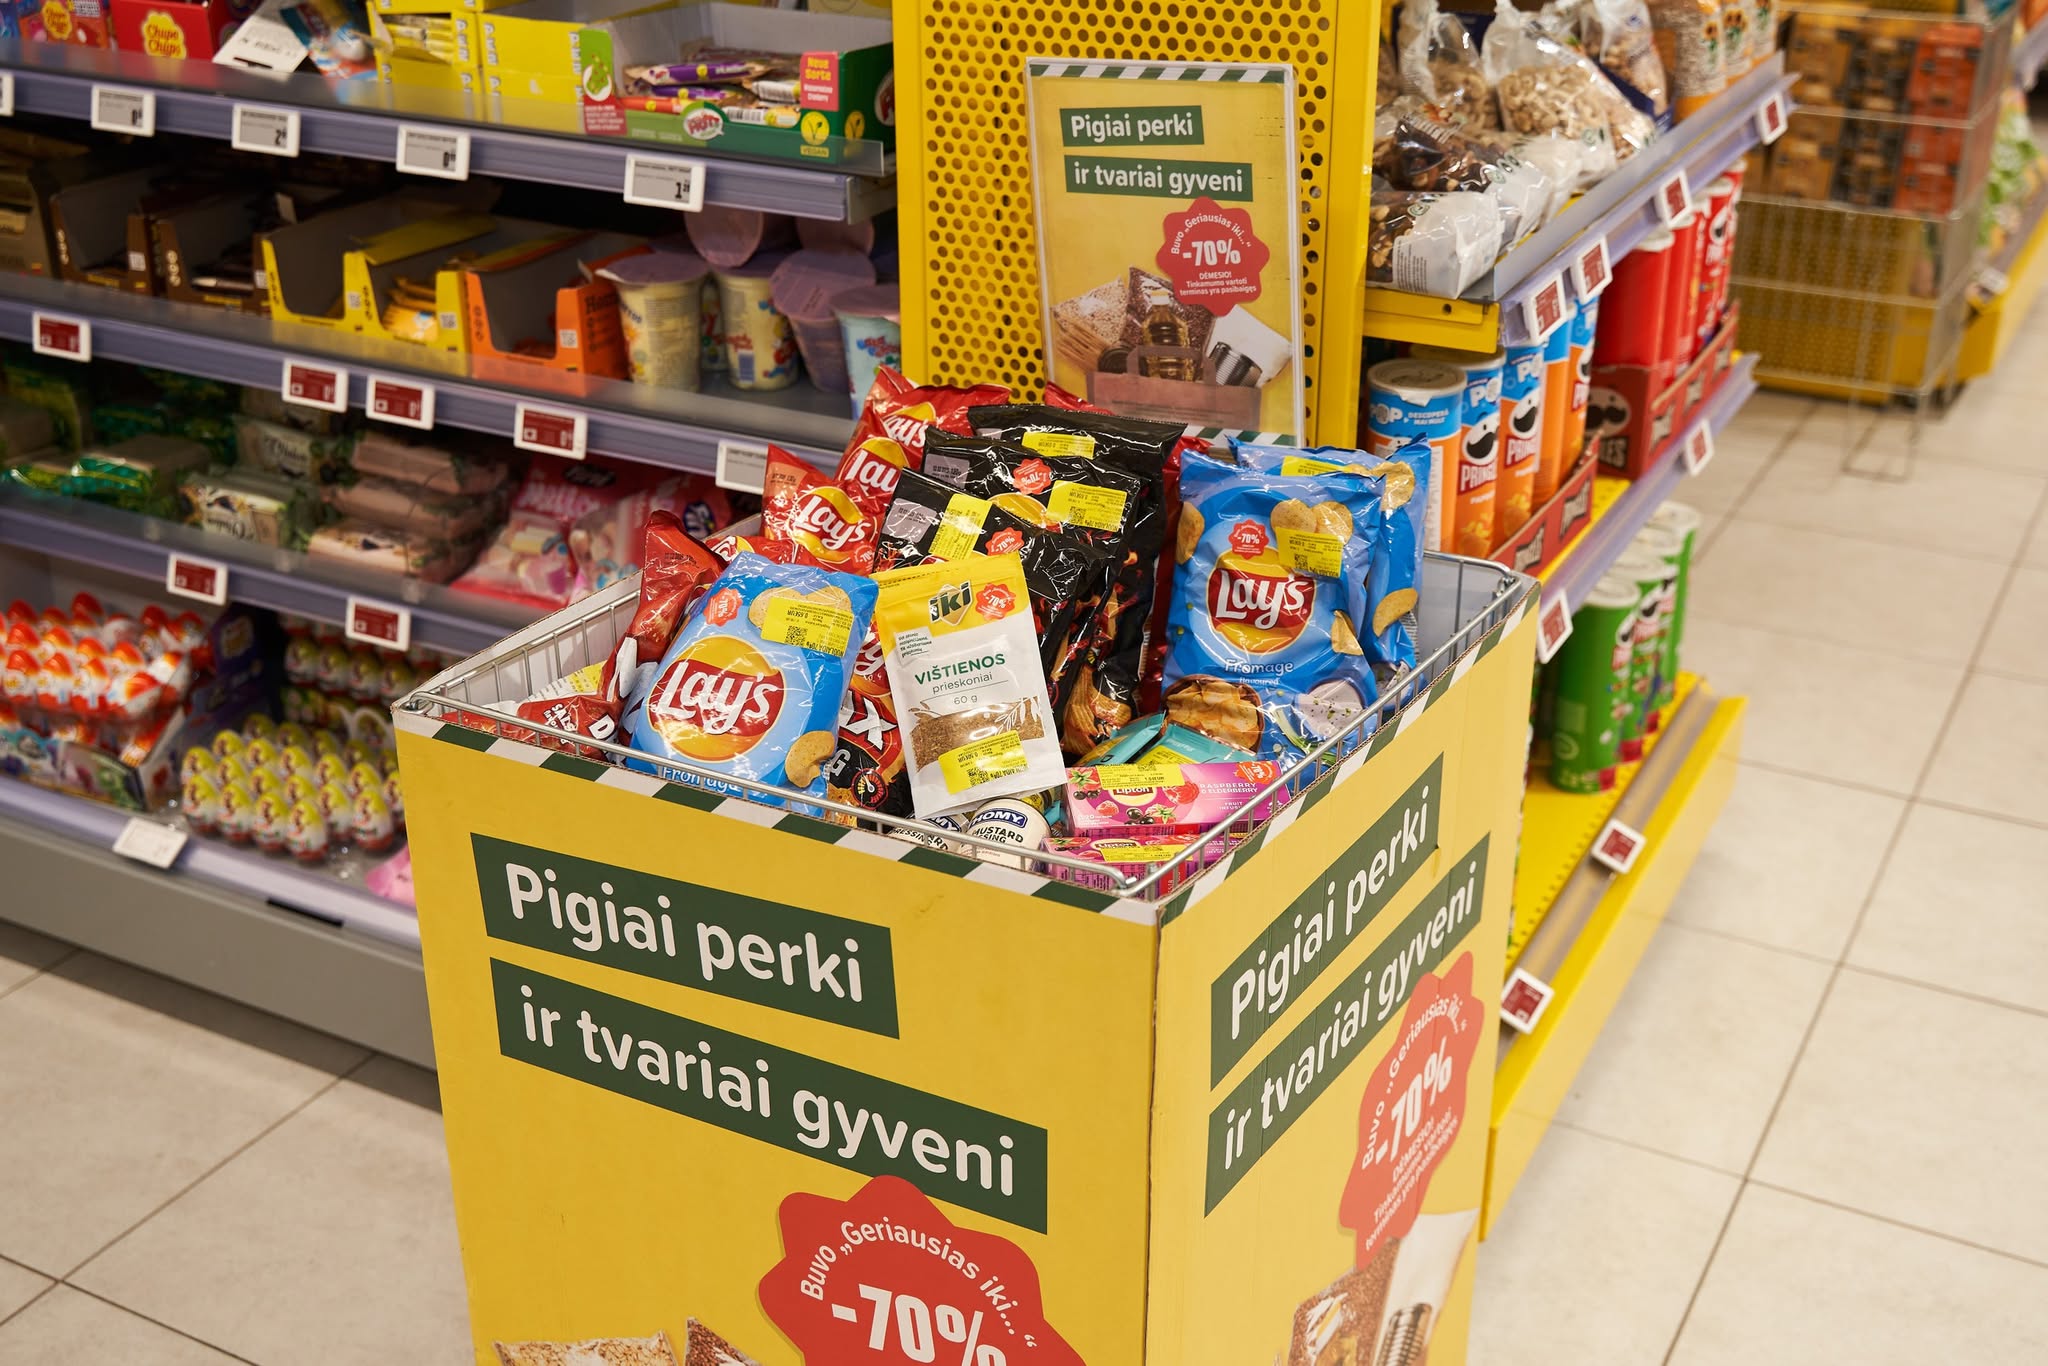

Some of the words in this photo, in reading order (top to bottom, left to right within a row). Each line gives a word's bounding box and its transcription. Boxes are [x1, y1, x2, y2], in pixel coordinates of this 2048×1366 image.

[147, 24, 178, 38] Chupa
[149, 39, 180, 56] Chups
[805, 68, 831, 81] Sorte
[1071, 113, 1131, 143] Pigiai
[1137, 112, 1193, 141] perki
[1074, 162, 1089, 184] ir
[1095, 164, 1163, 188] tvariai
[1169, 169, 1243, 195] gyveni
[1171, 231, 1184, 254] Buvo
[1185, 213, 1232, 233] „Geriausias
[1182, 238, 1241, 266] -70%
[1180, 286, 1208, 296] terminas
[1209, 288, 1221, 296] yra
[1186, 280, 1225, 288] Tinkamumo
[1225, 277, 1248, 286] vartoti
[793, 495, 872, 550] Lay's
[996, 536, 1015, 552] -70%
[1237, 533, 1260, 545] -70%
[930, 582, 971, 622] iki
[985, 594, 1006, 609] -70%
[1215, 570, 1308, 630] Lay's
[915, 653, 1006, 685] VIŠTIENOS
[1224, 658, 1294, 675] Fromage
[650, 661, 778, 735] Lay's
[932, 673, 993, 694] prieskoniai
[954, 695, 967, 705] 60
[971, 694, 978, 703] g
[1232, 881, 1336, 1040] Pigiai
[1345, 785, 1429, 936] perki
[505, 863, 676, 957] Pigiai
[696, 922, 863, 1003] perki
[1225, 1109, 1252, 1170] ir
[1261, 970, 1372, 1131] tvariai
[1378, 861, 1477, 1022] gyveni
[521, 984, 561, 1048] ir
[577, 1009, 771, 1118] tvariai
[793, 1089, 1014, 1197] gyveni
[1375, 1036, 1453, 1165] -70%
[1362, 1101, 1385, 1170] Buvo
[801, 1245, 837, 1301] Buvo
[840, 1216, 981, 1280] „Geriausias
[832, 1284, 1007, 1366] -70%
